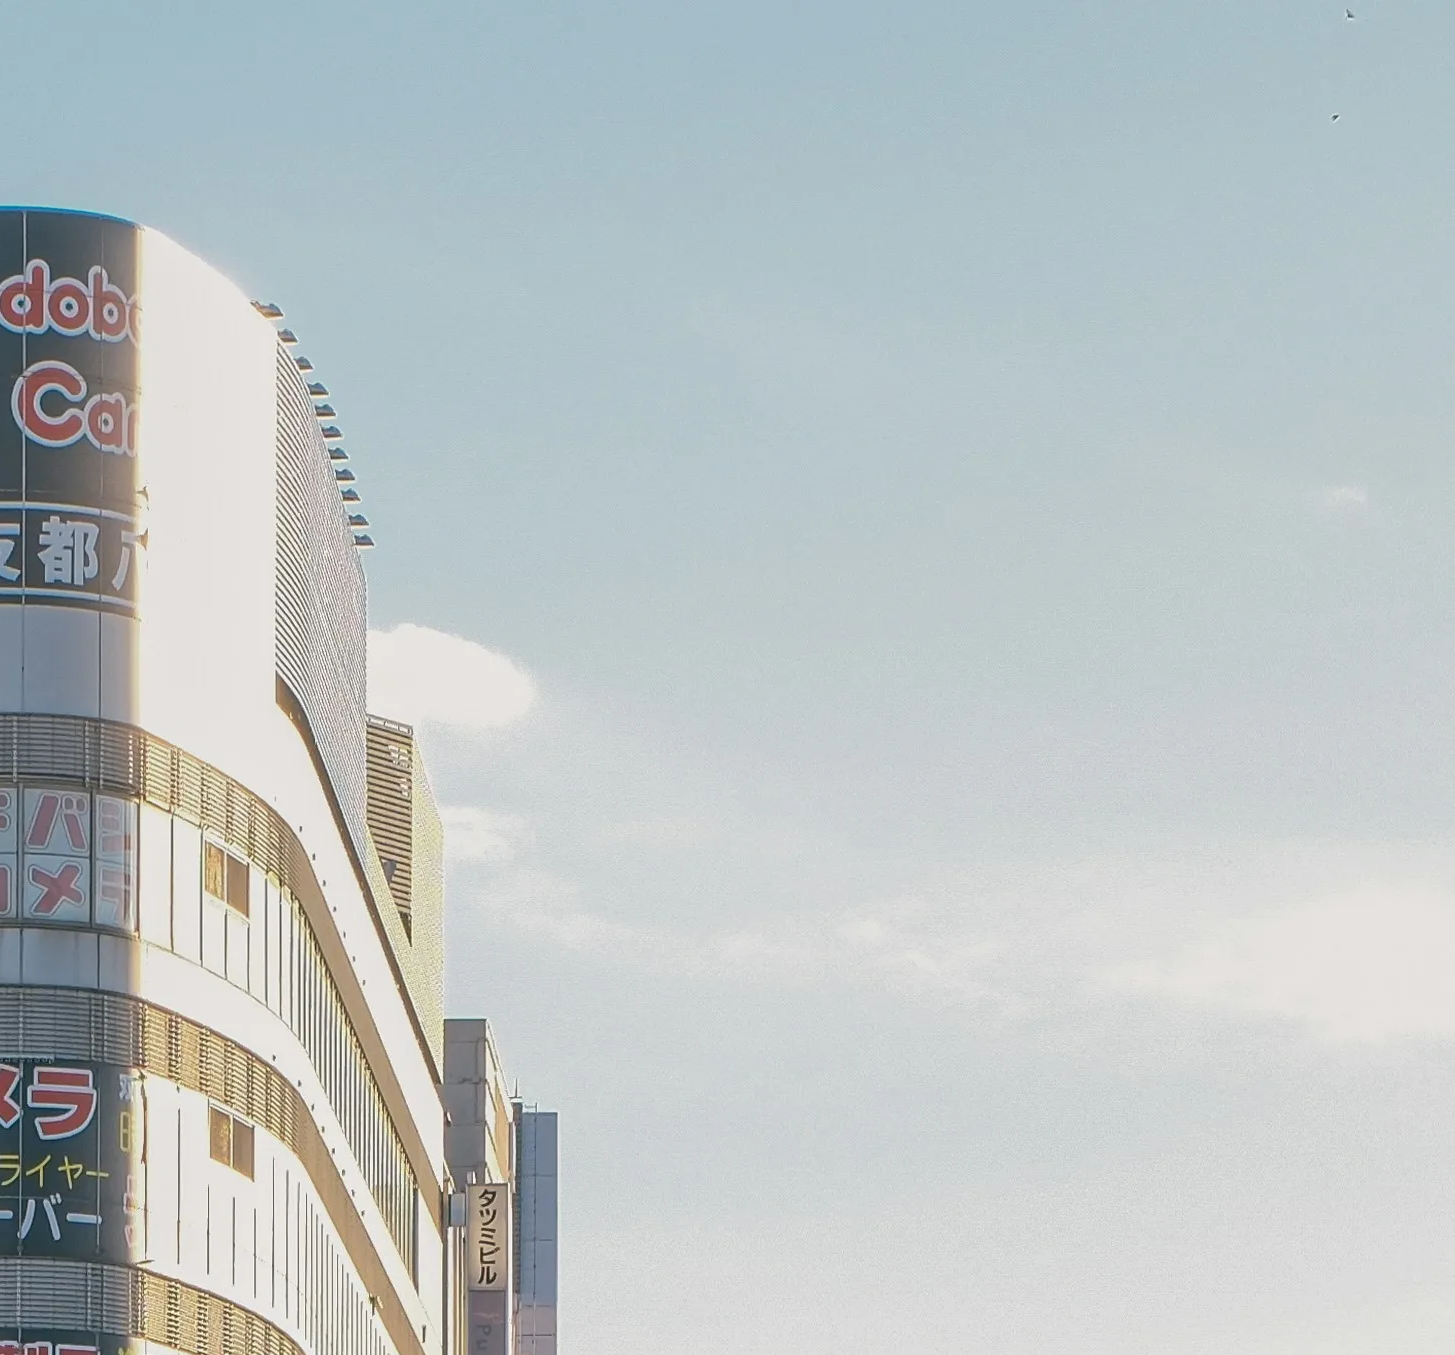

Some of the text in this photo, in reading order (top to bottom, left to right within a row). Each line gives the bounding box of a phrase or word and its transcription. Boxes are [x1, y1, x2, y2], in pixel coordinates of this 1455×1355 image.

[478, 1188, 501, 1285] タツミビル
